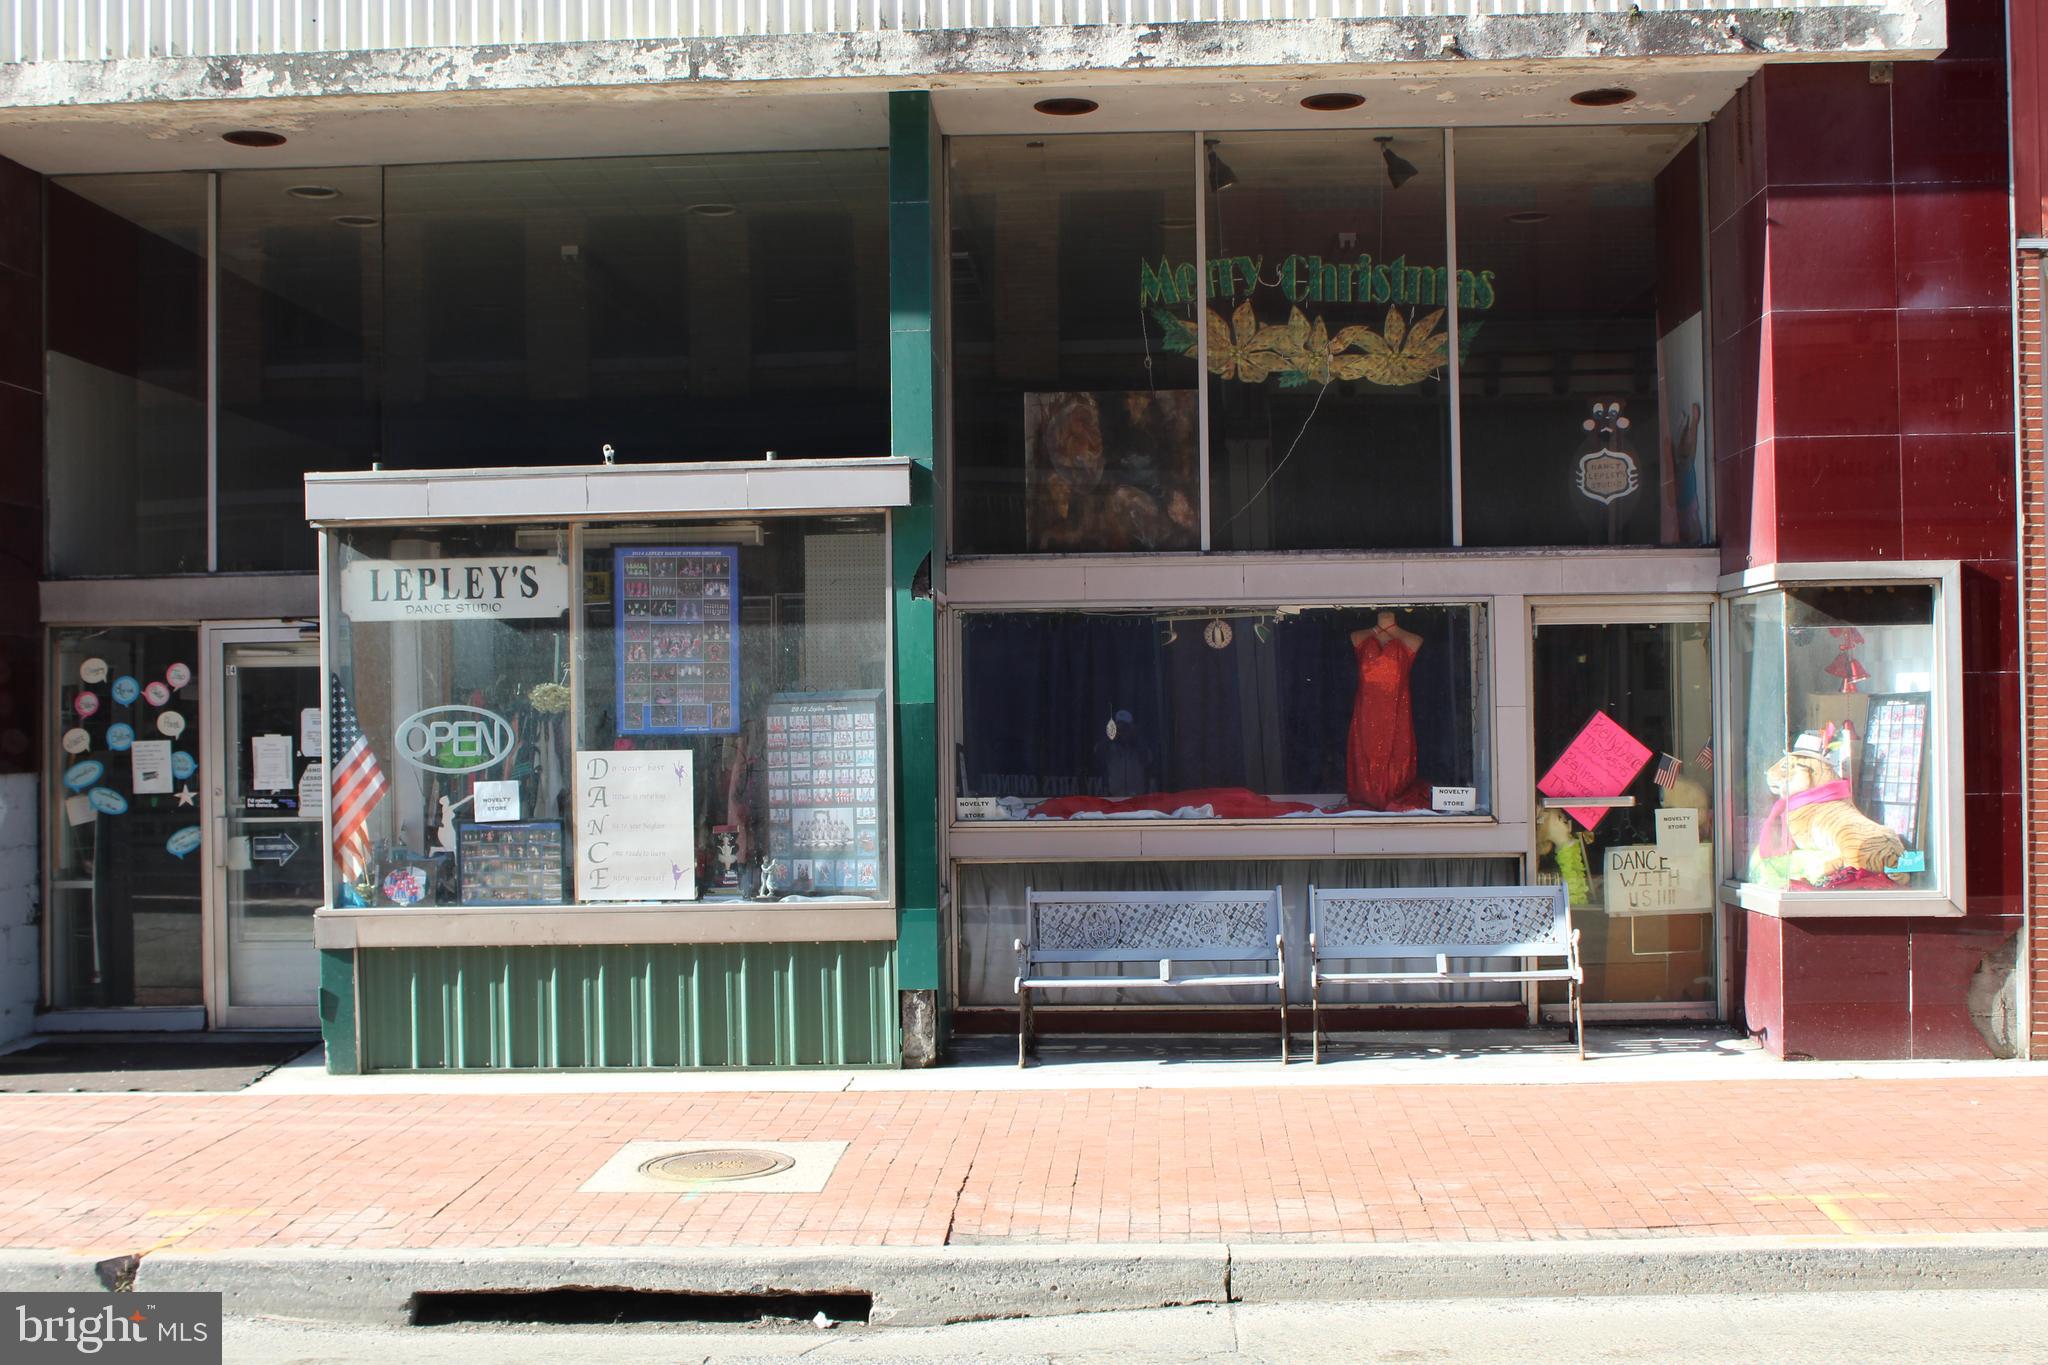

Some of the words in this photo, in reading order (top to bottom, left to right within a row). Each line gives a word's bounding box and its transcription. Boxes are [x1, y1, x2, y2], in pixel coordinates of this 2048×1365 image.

[1140, 253, 1263, 308] Merry
[1281, 252, 1495, 309] Christmas
[369, 565, 539, 602] LEPLEY'S
[406, 603, 450, 615] DANCE
[456, 602, 502, 613] STUDIO
[403, 720, 500, 757] OPEN
[1612, 850, 1671, 870] DANCE
[1620, 869, 1680, 887] WITH
